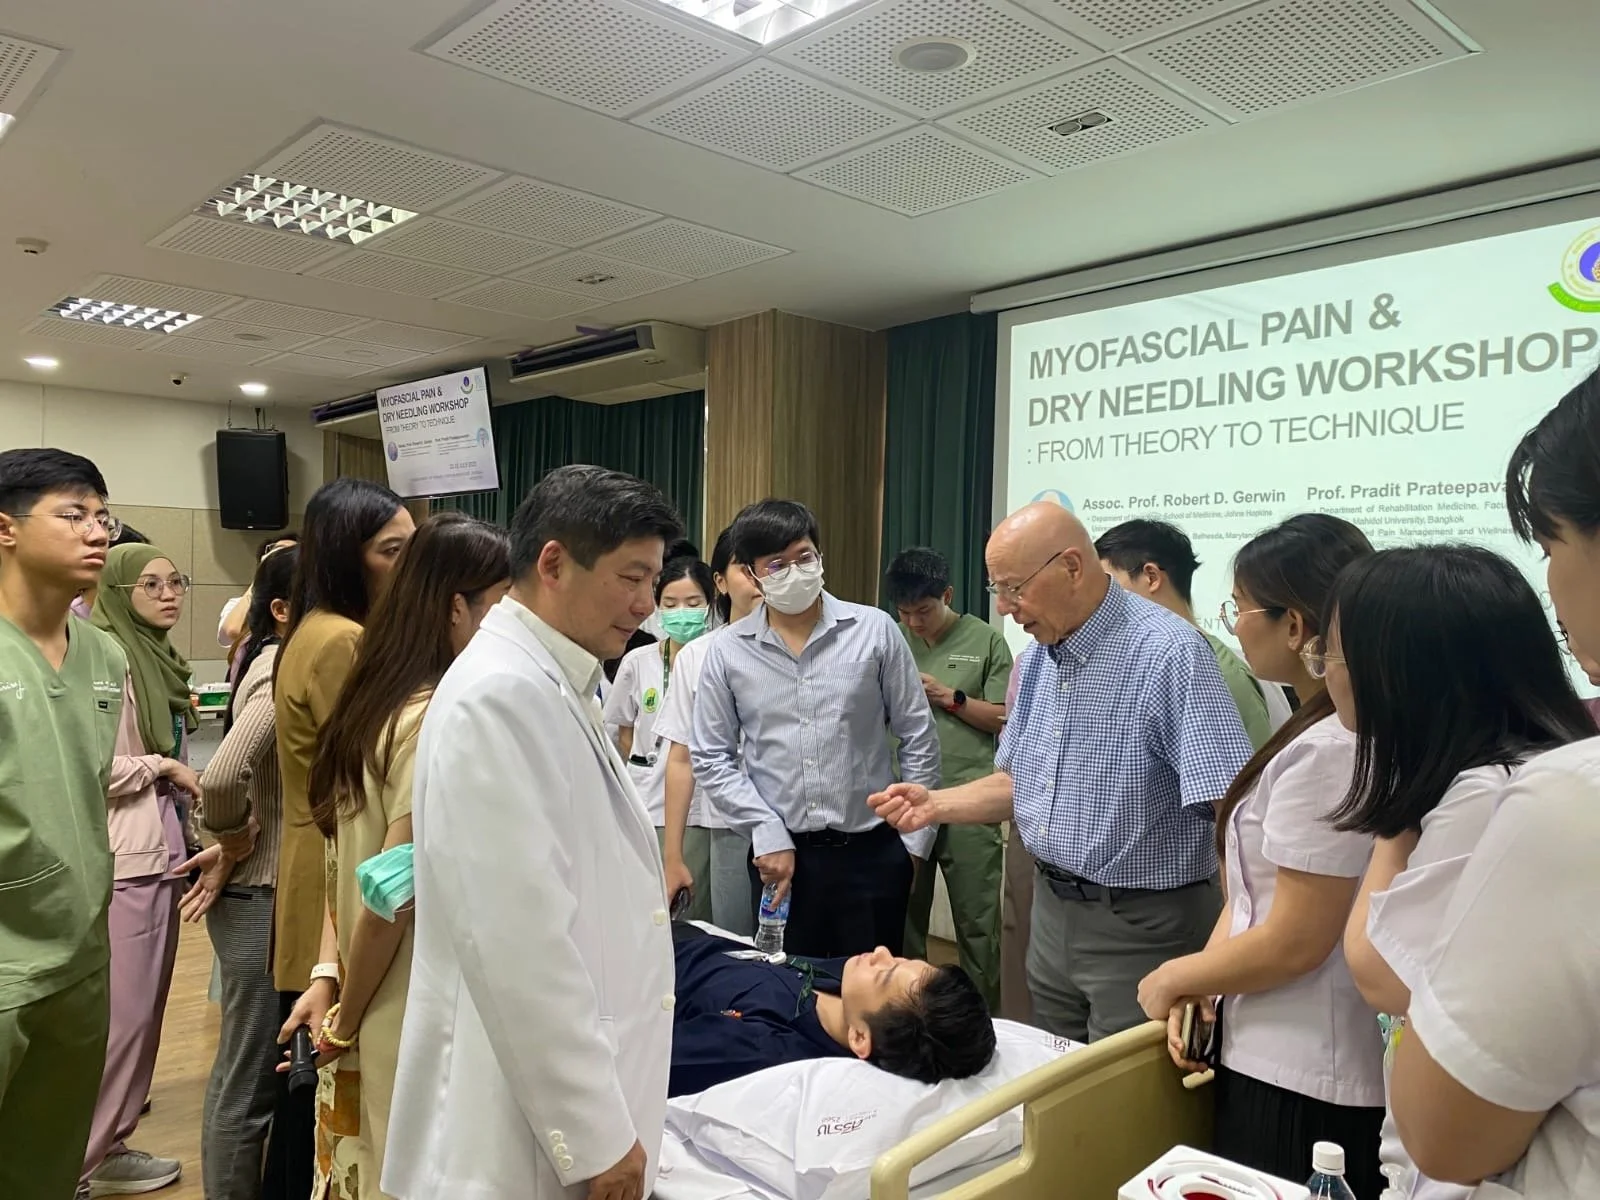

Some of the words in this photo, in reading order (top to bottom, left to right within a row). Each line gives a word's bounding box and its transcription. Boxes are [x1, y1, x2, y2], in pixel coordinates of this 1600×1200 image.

[1030, 318, 1248, 380] MYOFASCIAL
[1261, 299, 1352, 346] PAIN
[1369, 293, 1401, 330] &
[1029, 390, 1092, 427] DRY
[1099, 366, 1285, 418] NEEDLING
[1296, 327, 1598, 396] WORKSHOP
[380, 390, 420, 408] MYOFASCIAL
[421, 387, 436, 400] PAIN
[383, 411, 395, 423] DRY
[396, 404, 428, 420] NEEDLING
[429, 397, 469, 414] WORKSHOP
[1038, 436, 1103, 464] FROM
[1109, 425, 1217, 456] THEORY
[1224, 421, 1262, 447] TO
[1269, 402, 1464, 443] TECHNIQUE
[1082, 498, 1124, 511] Assoc.
[1128, 495, 1159, 508] Prof.
[1164, 493, 1210, 507] Robert
[1214, 491, 1228, 504] D.
[1233, 489, 1285, 503] Gerwin
[1307, 485, 1345, 500] Prof.
[1350, 483, 1401, 498] Pradit
